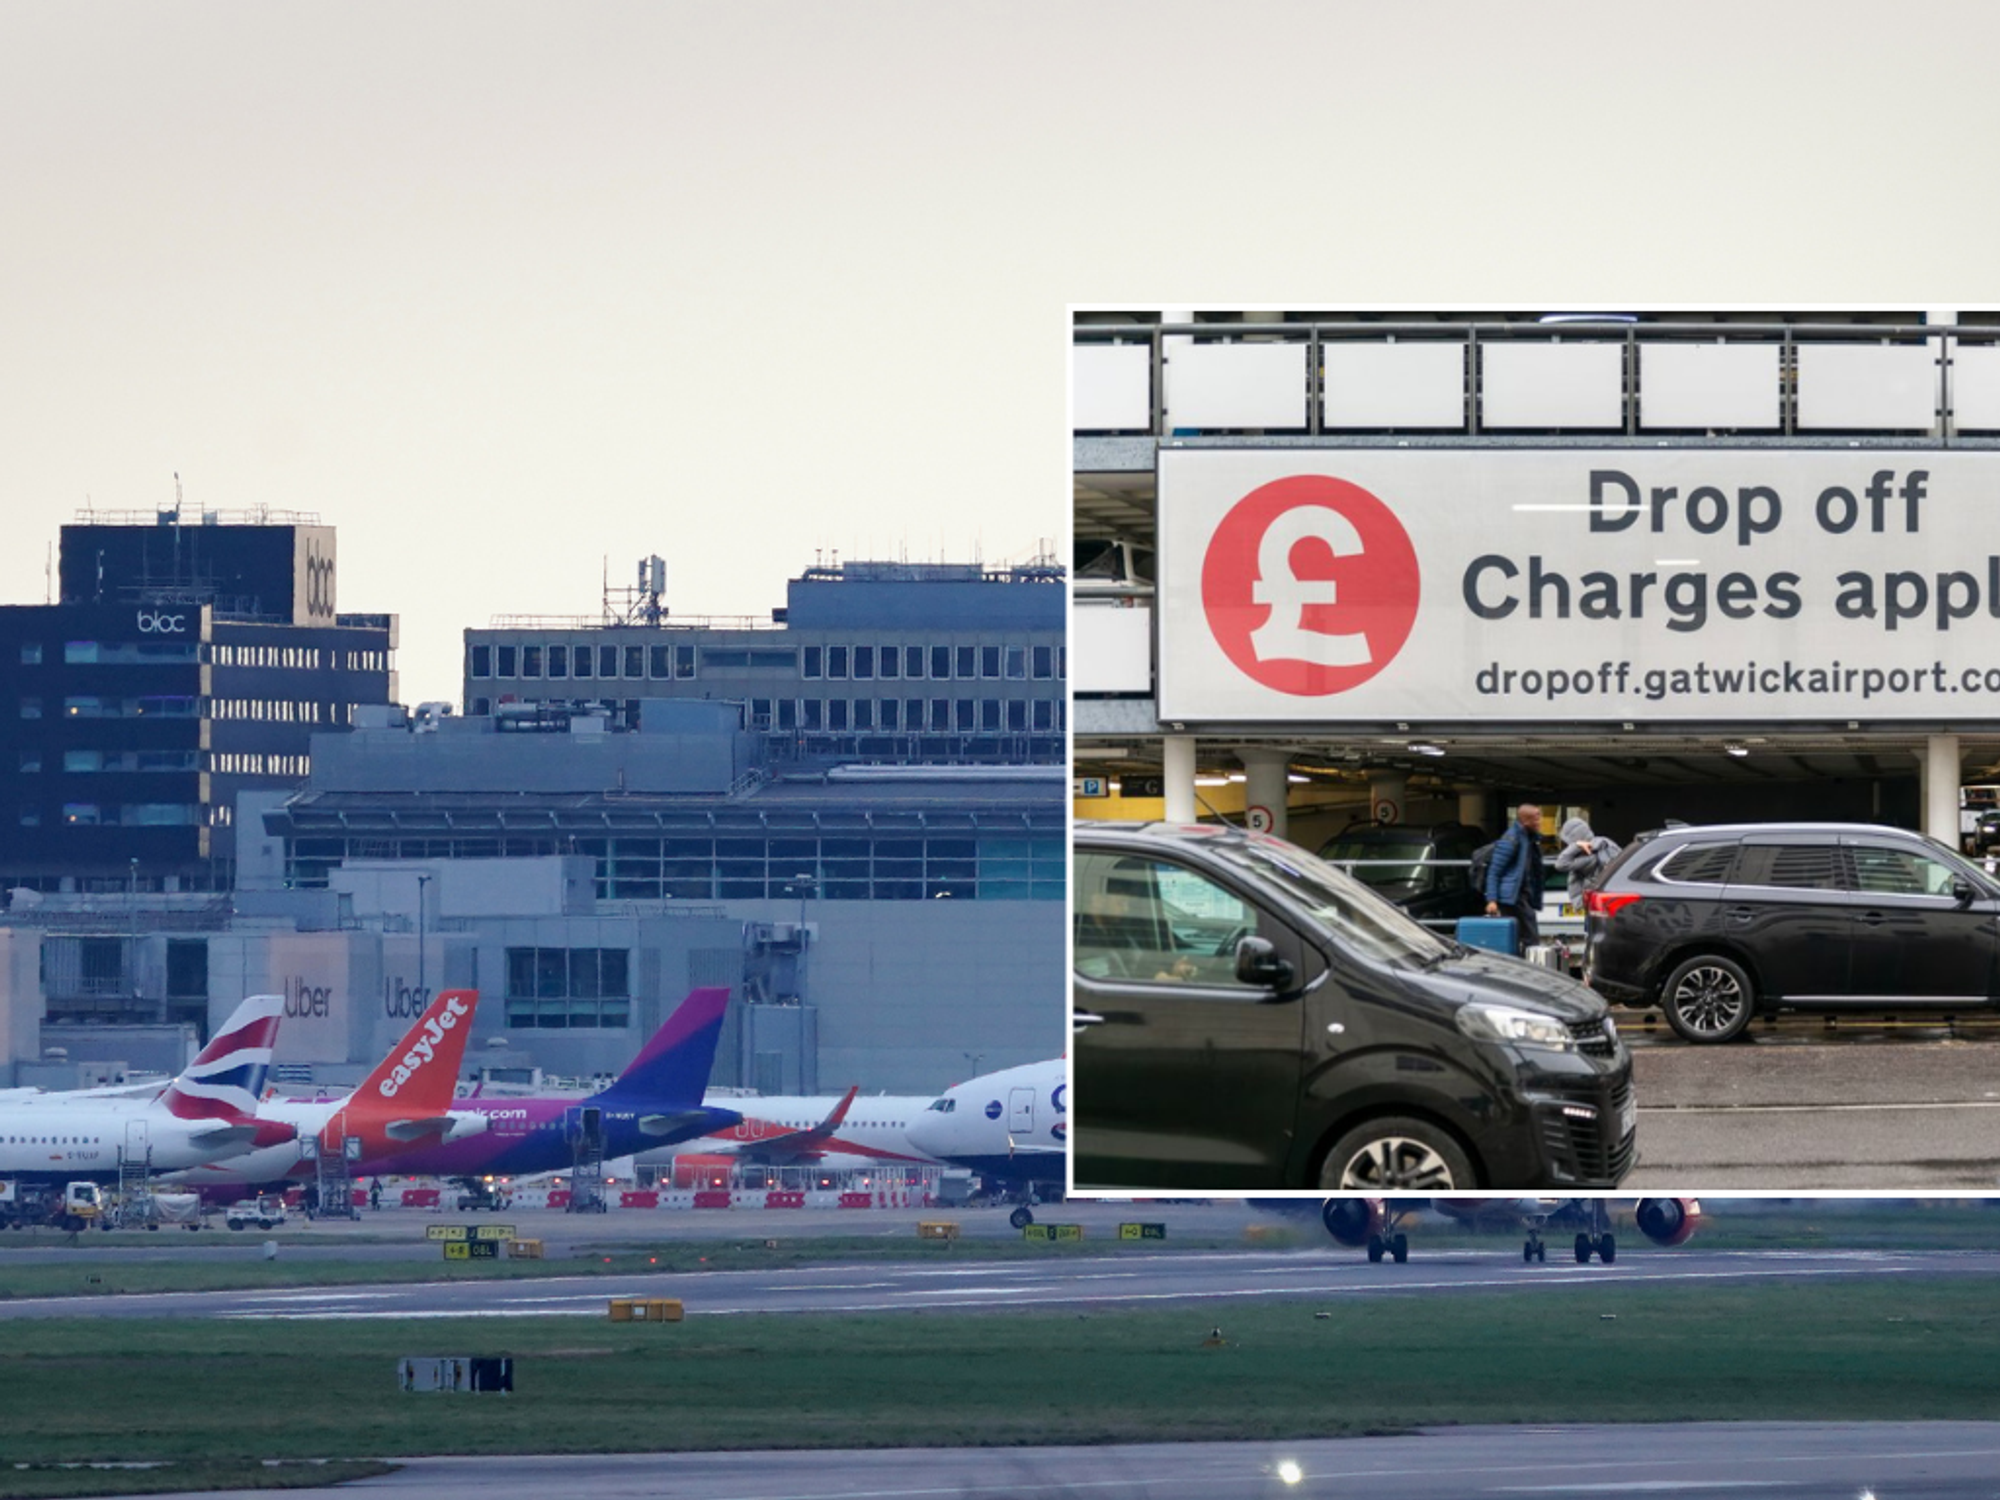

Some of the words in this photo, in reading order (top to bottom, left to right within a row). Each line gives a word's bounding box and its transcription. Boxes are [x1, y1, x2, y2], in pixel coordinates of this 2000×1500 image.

[1590, 470, 1783, 546] Drop
[1815, 469, 1930, 535] off
[1250, 504, 1373, 667] £
[1462, 554, 1803, 633] Charges
[137, 609, 186, 633] bloc
[1475, 660, 2000, 701] dropoff.gatwickairport.co
[1252, 814, 1262, 829] 5
[1380, 806, 1390, 819] 5
[284, 975, 333, 1019] Uber
[385, 975, 431, 1019] Uber
[379, 996, 469, 1097] easyJet
